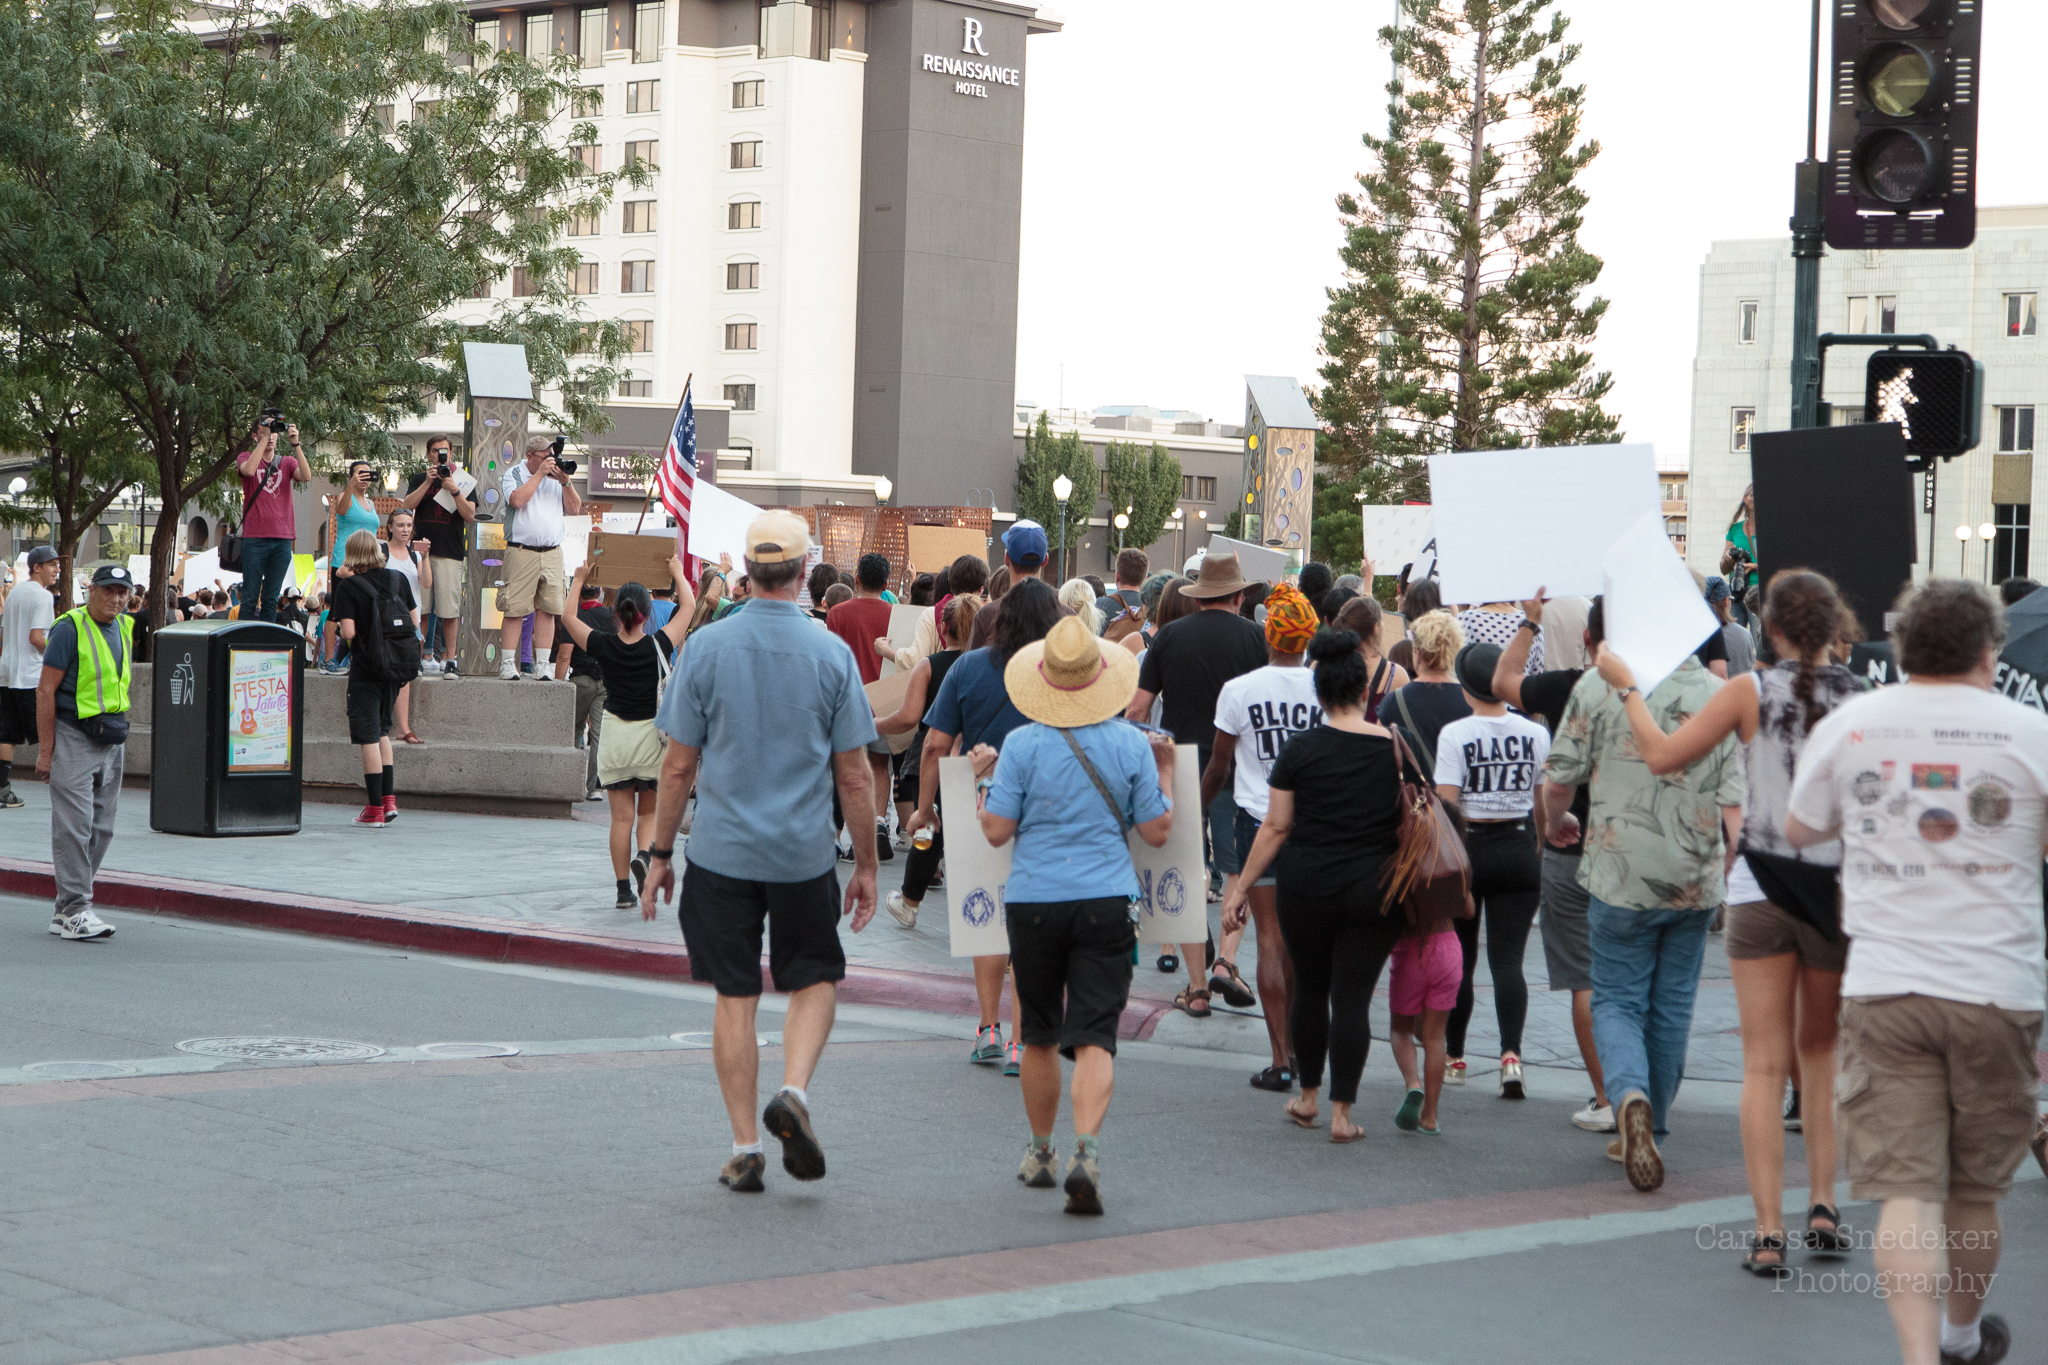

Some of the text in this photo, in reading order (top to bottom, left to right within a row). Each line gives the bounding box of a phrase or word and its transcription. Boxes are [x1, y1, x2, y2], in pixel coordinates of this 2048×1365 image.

[962, 17, 989, 56] R
[923, 53, 1020, 87] RENAISSANCE
[955, 81, 988, 98] HOTEL
[1926, 474, 1934, 508] west
[233, 677, 288, 701] FIESTA
[1248, 701, 1324, 731] BLACK
[1463, 735, 1535, 767] BLACK
[1463, 764, 1533, 793] LIVES
